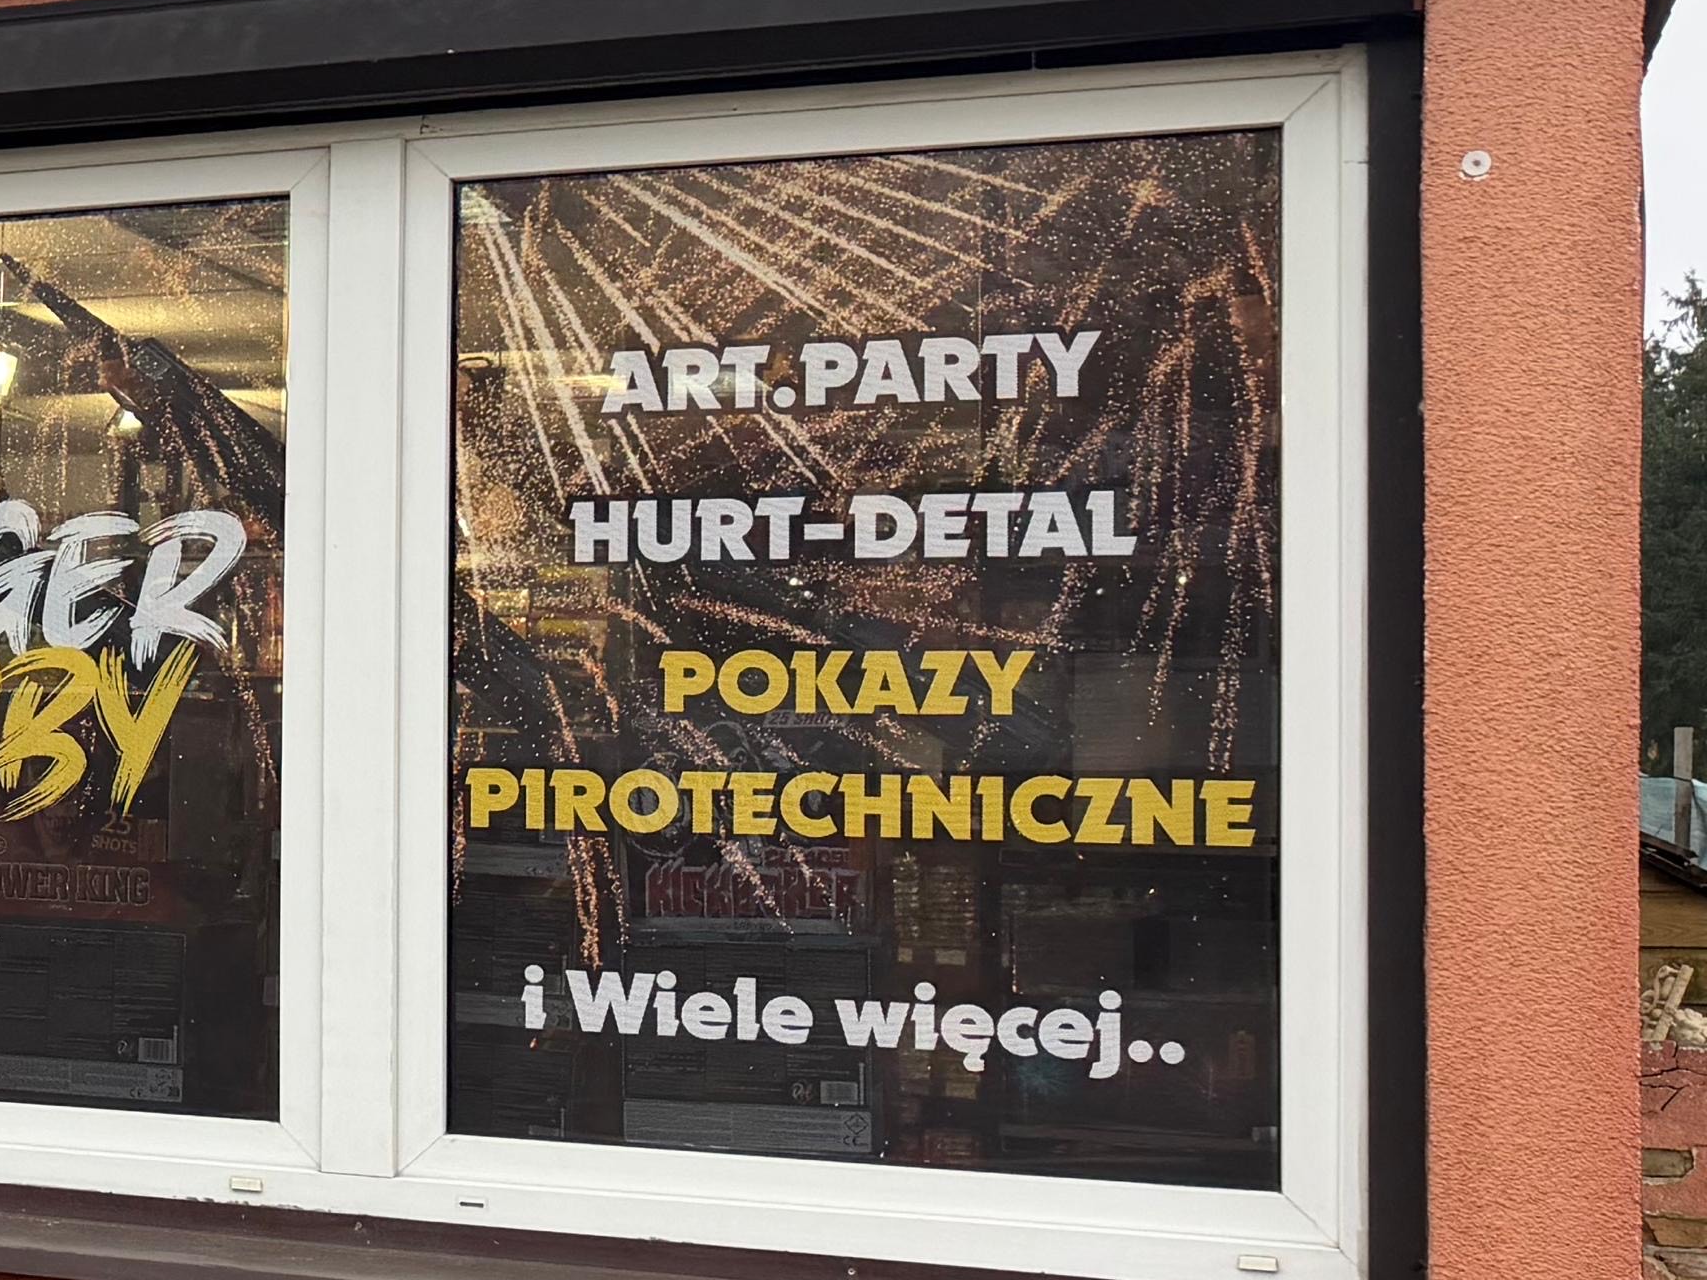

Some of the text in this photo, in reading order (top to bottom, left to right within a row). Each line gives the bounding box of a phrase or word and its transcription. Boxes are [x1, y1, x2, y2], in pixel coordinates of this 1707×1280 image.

[599, 330, 1102, 414] ART.PARTY
[567, 489, 1138, 564] HURT-DETAL
[658, 650, 1035, 716] POKAZY
[91, 835, 138, 854] SHOTS
[465, 768, 1256, 847] PIROTECHNICZNE
[76, 864, 152, 907] KING
[521, 964, 547, 1030] i
[565, 969, 813, 1044] Wiele
